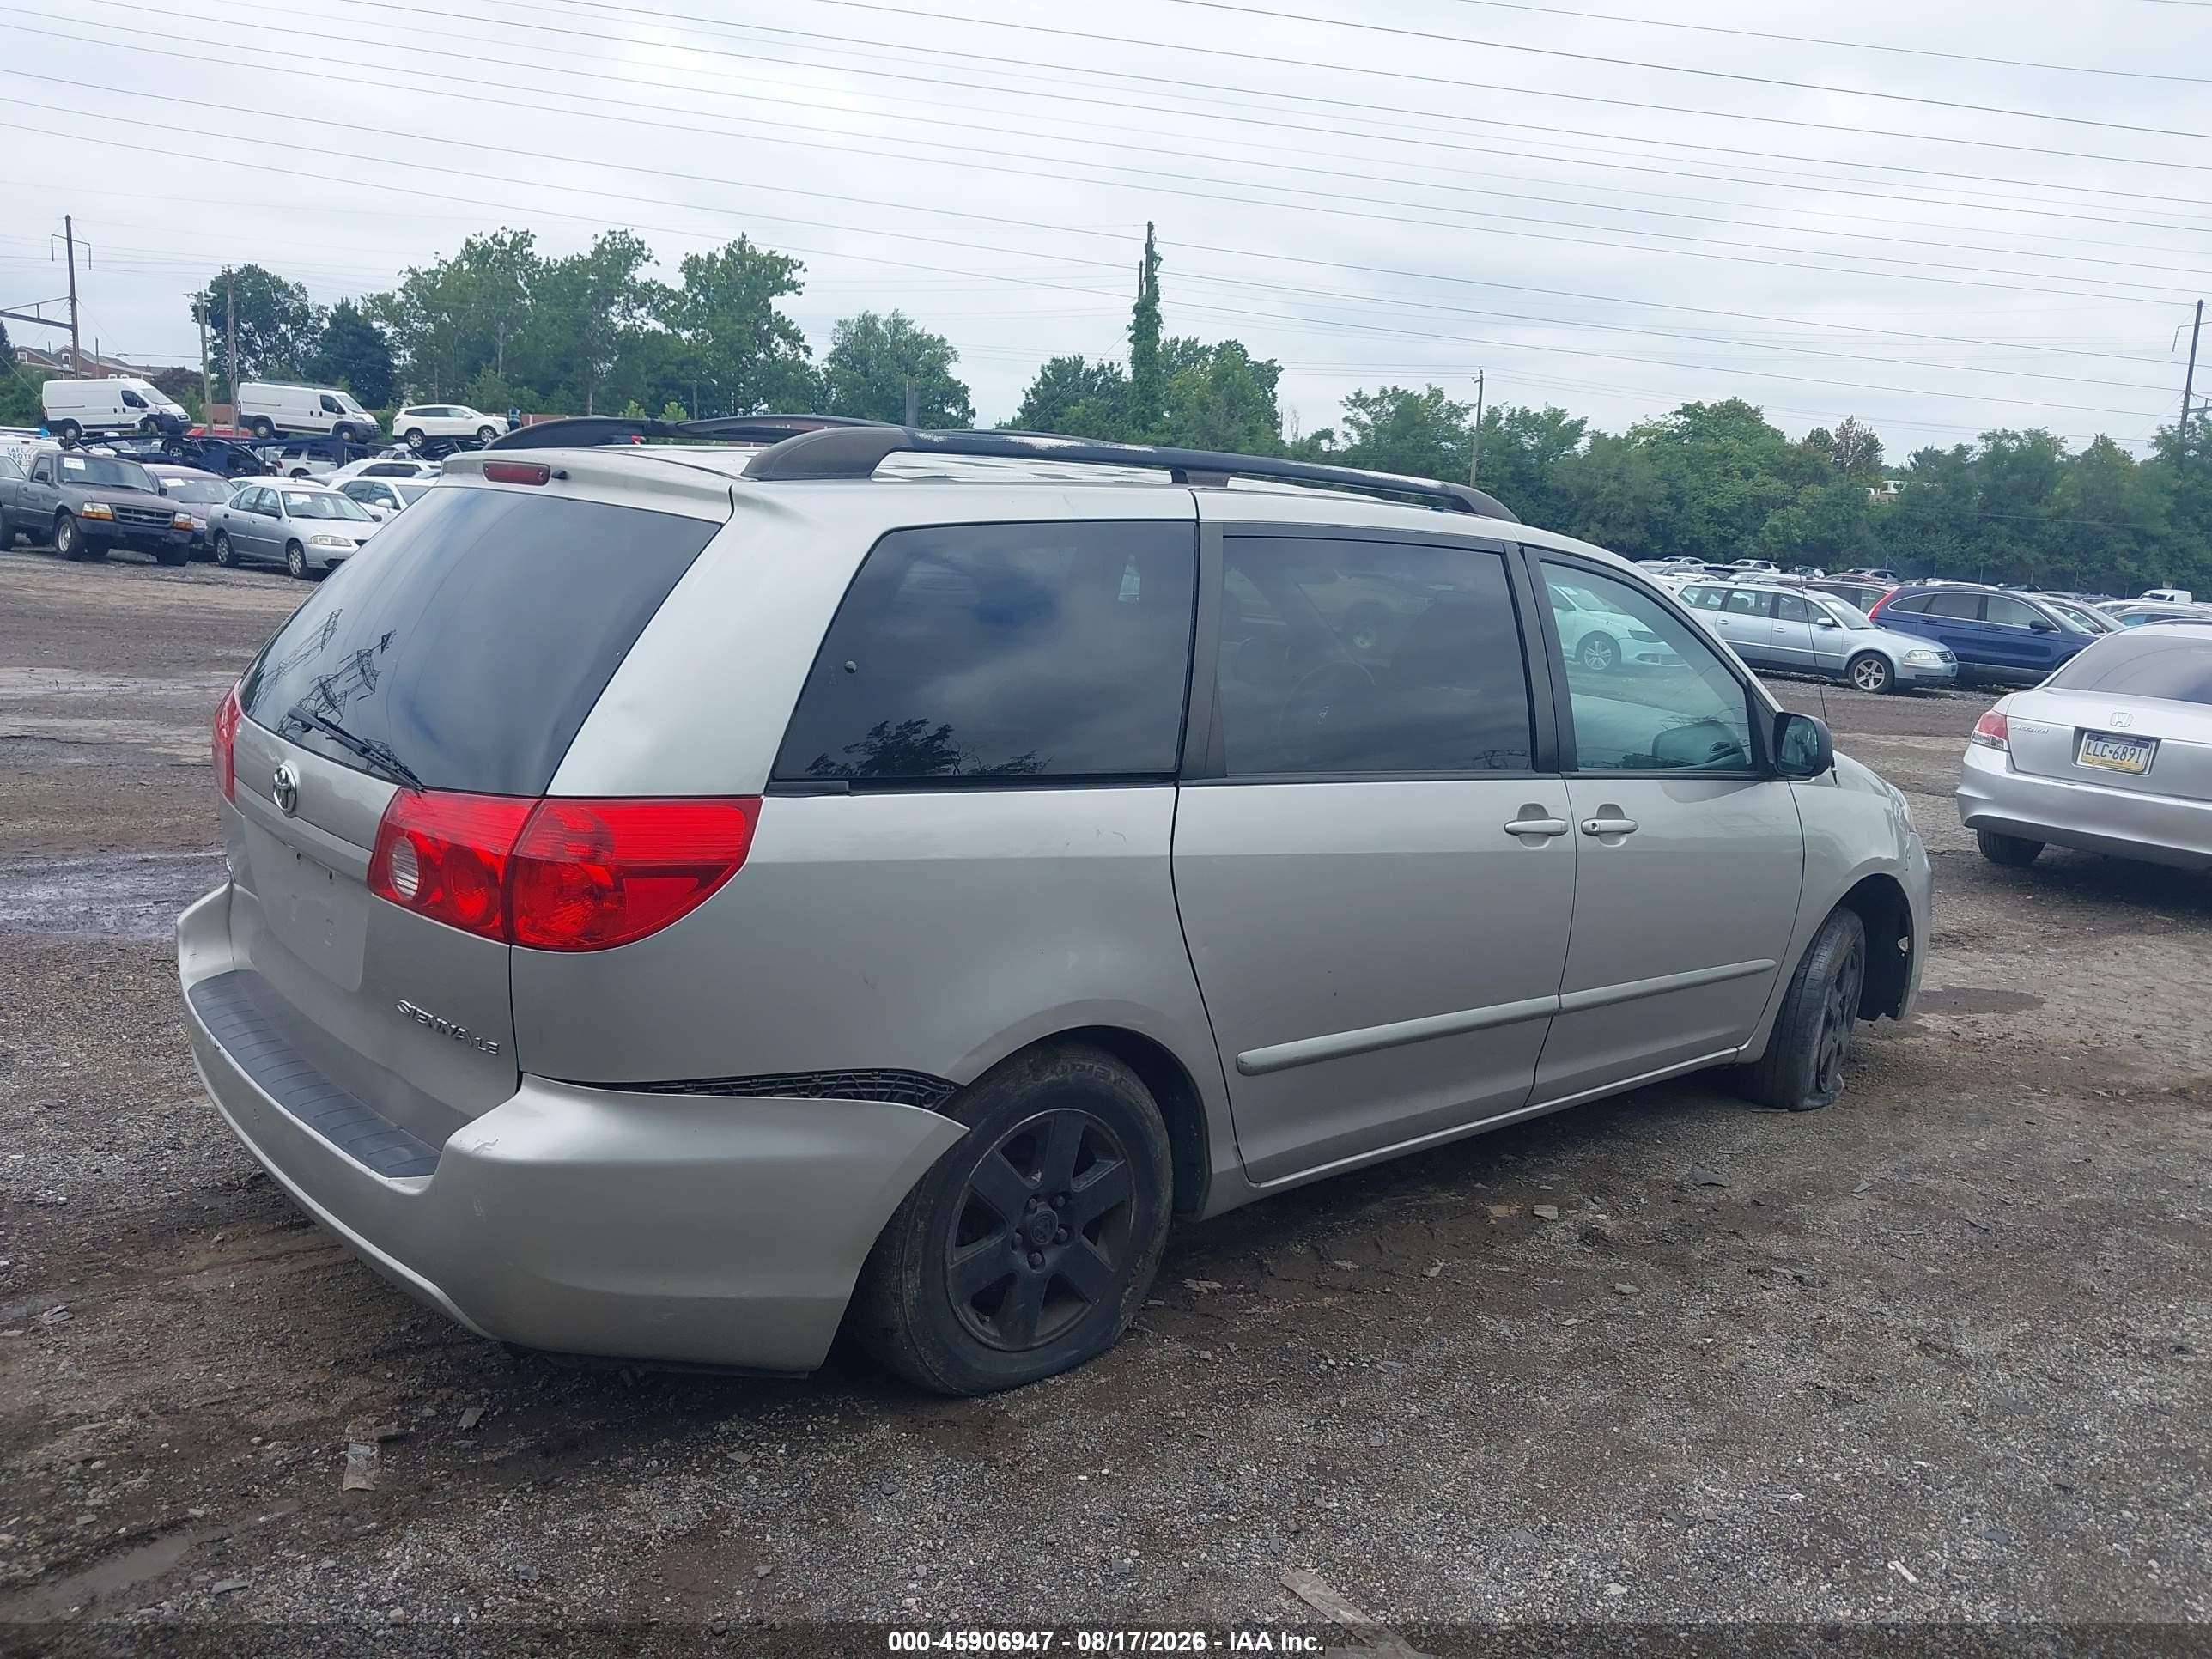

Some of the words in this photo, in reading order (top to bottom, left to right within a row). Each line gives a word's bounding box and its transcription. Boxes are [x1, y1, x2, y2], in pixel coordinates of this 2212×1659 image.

[2011, 725, 2049, 734] Accord
[396, 999, 473, 1046] SIENNA
[475, 1036, 500, 1055] LE
